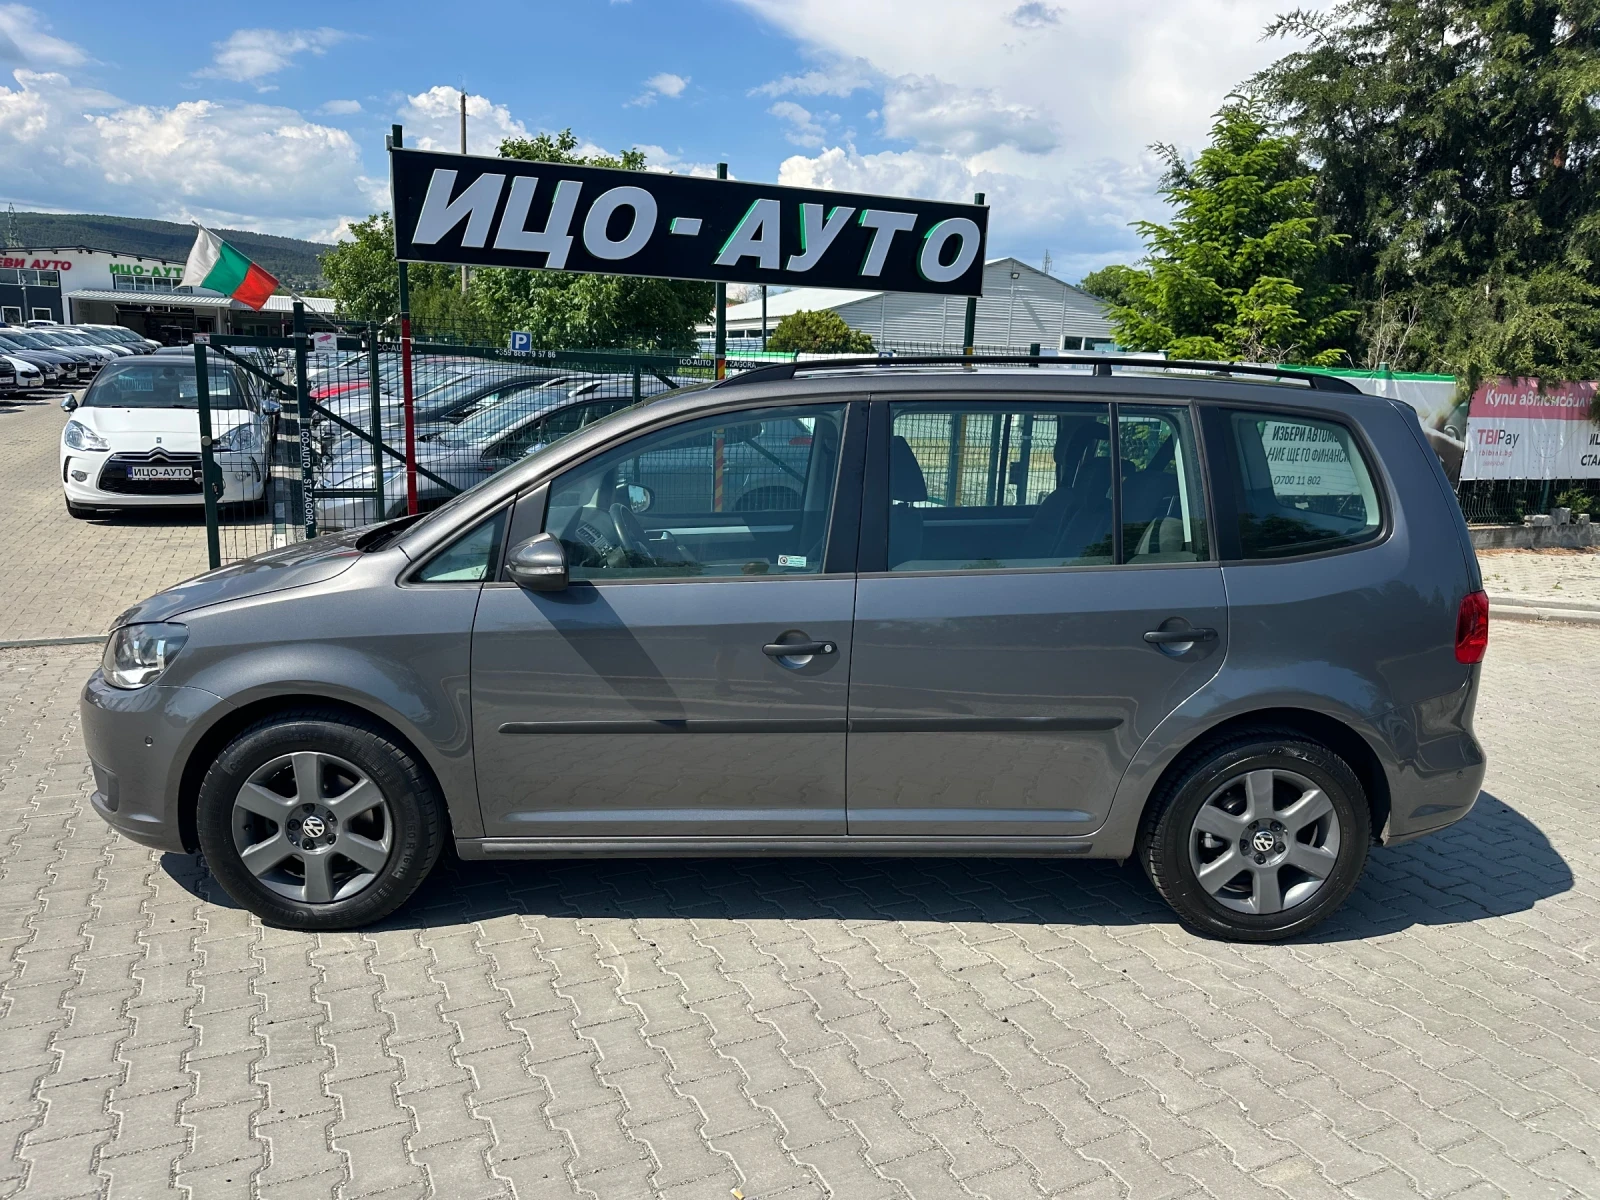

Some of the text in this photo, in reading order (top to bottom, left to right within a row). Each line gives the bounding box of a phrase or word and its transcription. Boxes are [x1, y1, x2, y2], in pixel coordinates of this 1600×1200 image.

[30, 259, 72, 271] АУТО
[109, 263, 183, 278] ИЦО-АУТ
[515, 333, 527, 349] P
[1272, 425, 1306, 441] ИЗБЕРИ
[1477, 429, 1520, 449] TBIPay
[1286, 447, 1300, 464] ЩЕ
[134, 468, 192, 478] ИЦО-АУТО
[1296, 476, 1305, 485] 11
[1307, 476, 1321, 486] 802
[304, 491, 313, 526] ZAGORA
